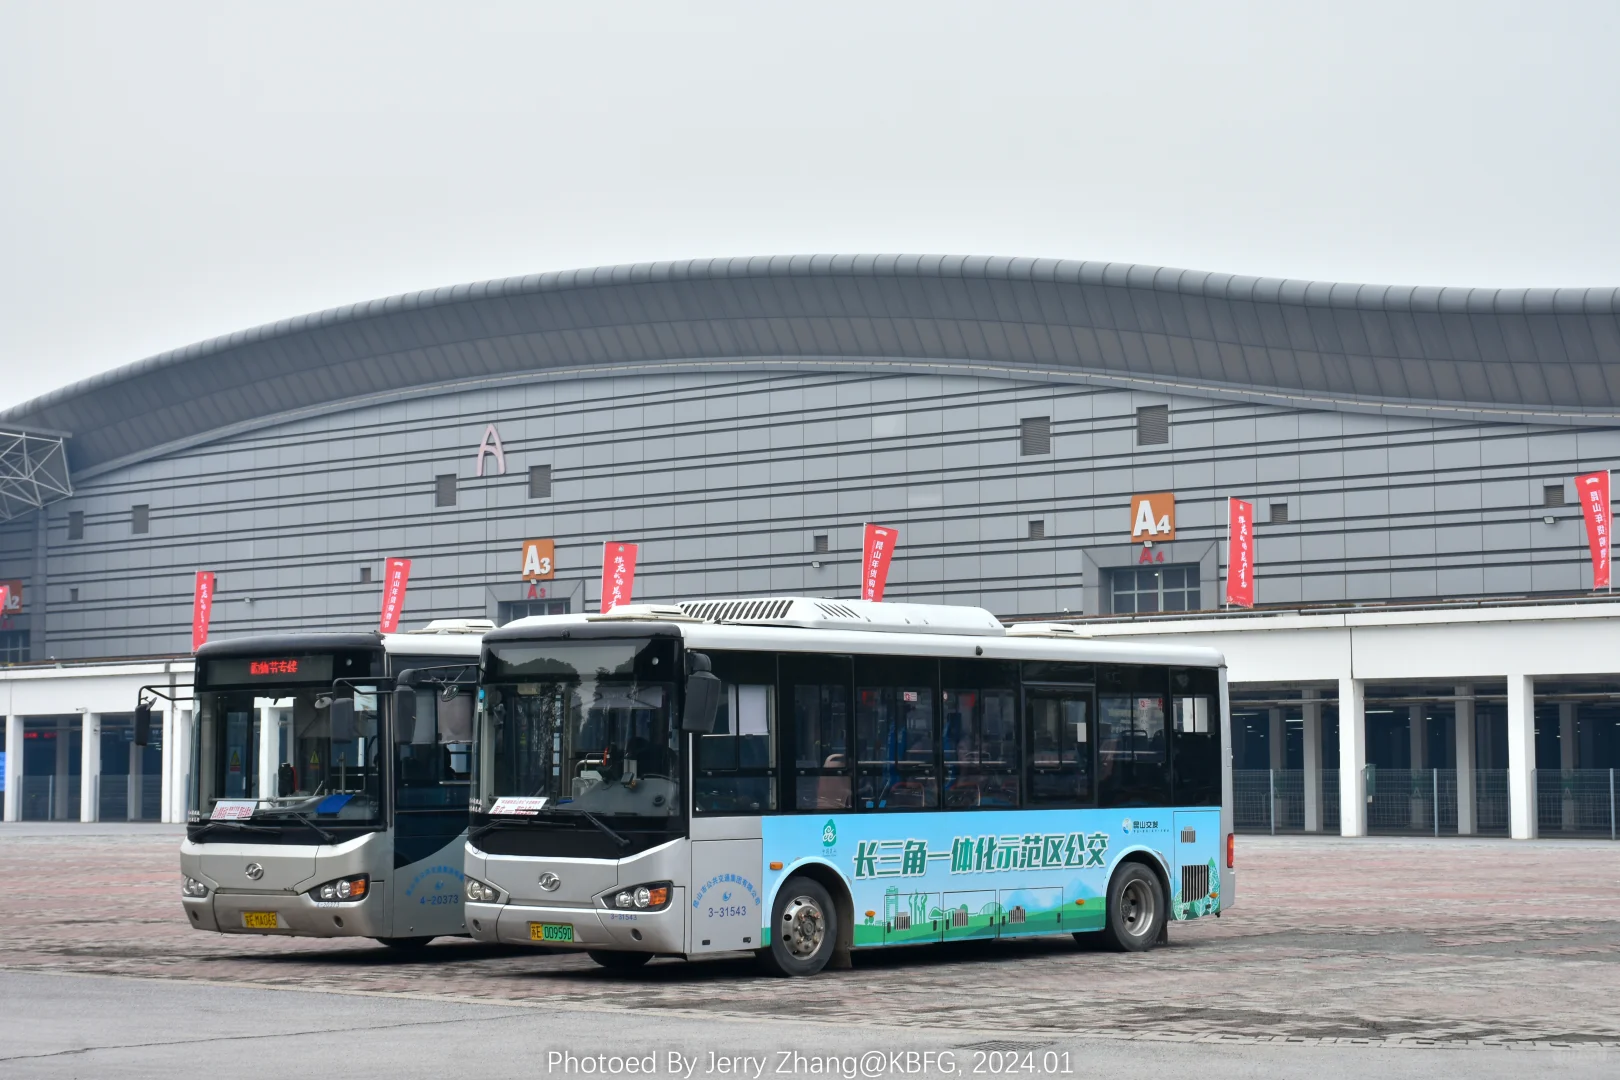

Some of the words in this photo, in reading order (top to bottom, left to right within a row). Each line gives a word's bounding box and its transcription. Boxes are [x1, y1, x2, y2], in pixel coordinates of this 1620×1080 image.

[476, 423, 506, 477] A
[1133, 500, 1171, 536] A4
[522, 545, 550, 575] A3
[1139, 547, 1165, 564] A4
[867, 540, 884, 602] 昆山年货购物
[527, 583, 546, 599] A3
[853, 832, 1110, 880] 长三角一体化示范区公交
[420, 895, 459, 905] 4-20373
[693, 874, 761, 908] 昆山市公共交通集团有限公司
[610, 913, 638, 921] 3-31543
[708, 906, 747, 918] 3-31543
